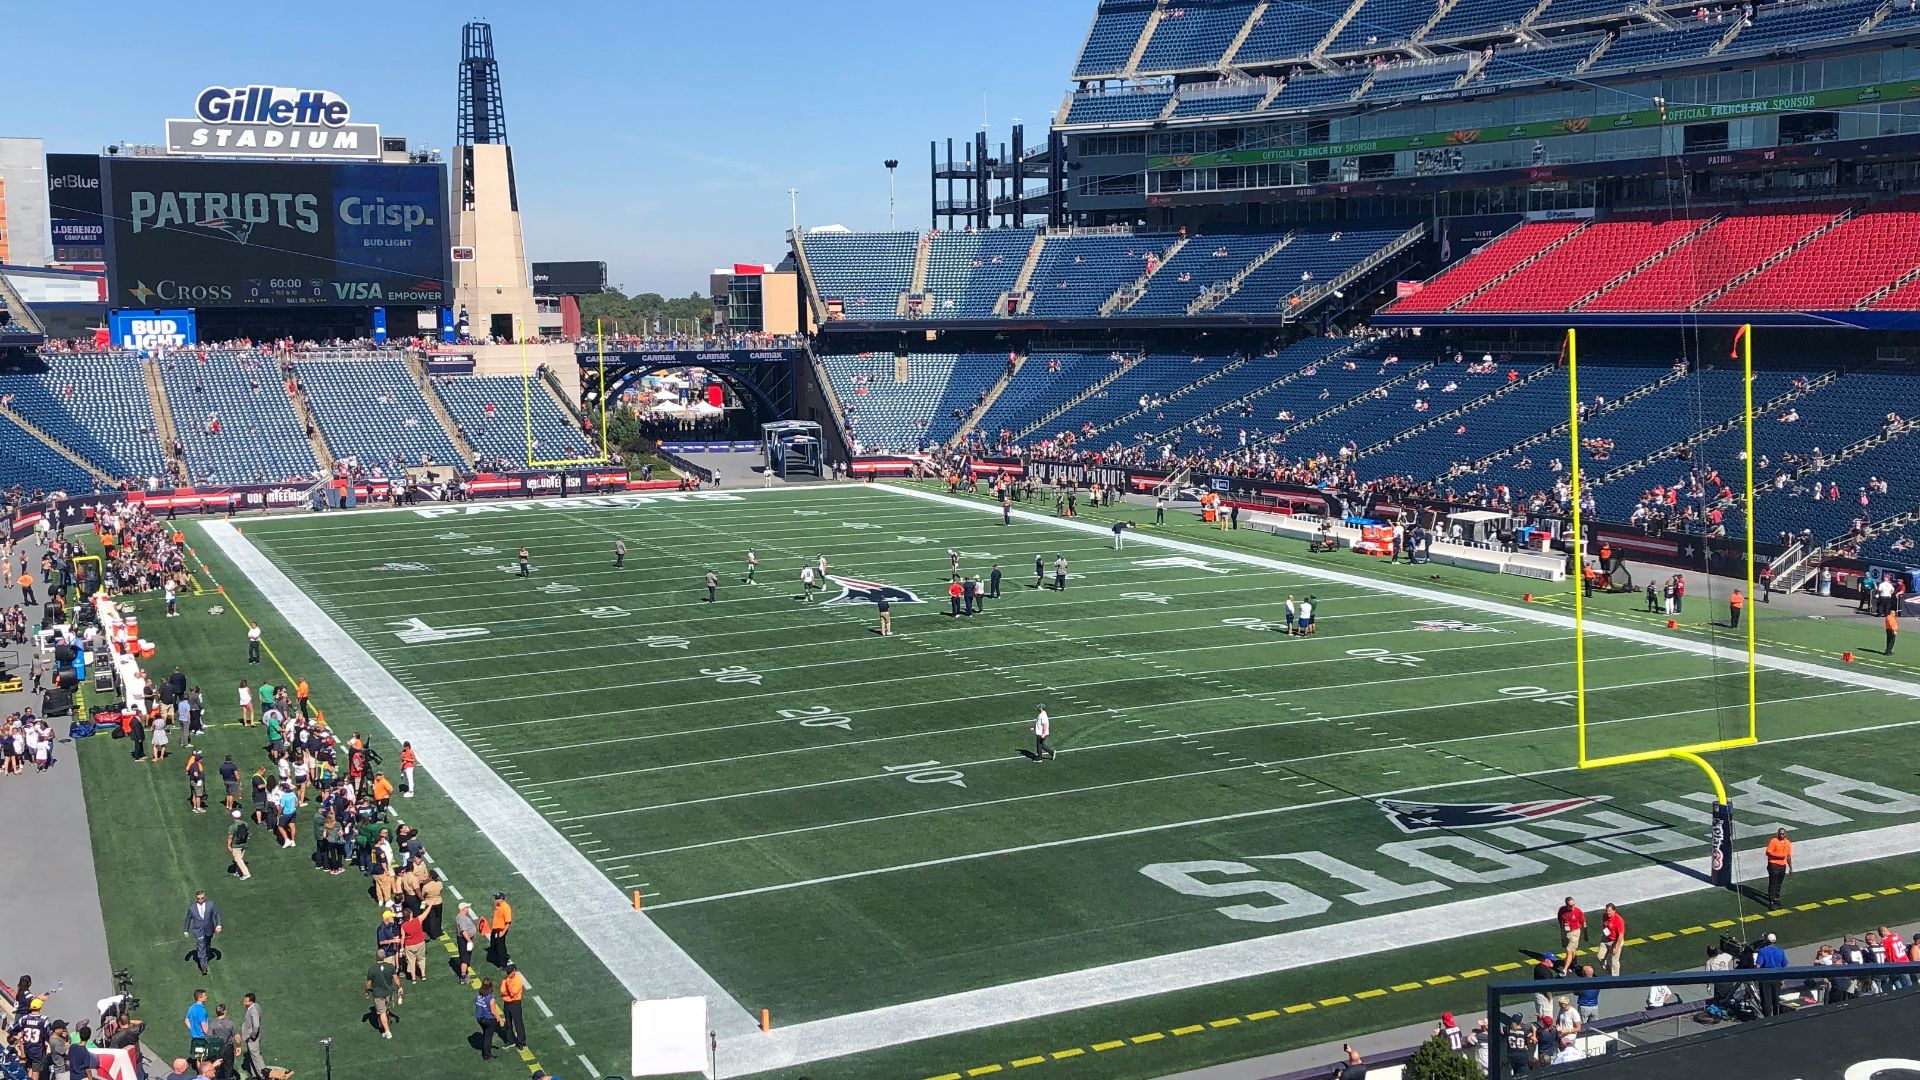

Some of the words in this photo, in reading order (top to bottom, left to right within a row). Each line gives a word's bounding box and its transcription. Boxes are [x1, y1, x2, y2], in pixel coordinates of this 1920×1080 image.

[197, 85, 349, 128] Gillette
[1668, 108, 1706, 121] OFFICIAL
[1711, 104, 1749, 116] FRENCH
[1750, 101, 1768, 112] FRY
[1773, 95, 1815, 110] SPONSOR
[190, 128, 358, 150] STADIUM
[1262, 148, 1295, 160] OFFICIAL
[1298, 146, 1328, 158] FRENCH
[1329, 144, 1343, 155] FRY
[1345, 141, 1377, 153] SPONSOR
[50, 174, 99, 190] jetBlue
[131, 191, 320, 234] PATRIOTS
[339, 196, 434, 231] Crisp.
[363, 238, 385, 247] BUD
[386, 238, 413, 247] LIGHT
[251, 287, 259, 297] 0
[270, 278, 302, 288] 60:00
[313, 287, 321, 296] 0
[330, 282, 383, 300] VISA
[388, 291, 442, 301] EMPOWER
[131, 319, 177, 335] BUD
[123, 334, 186, 350] LIGHT
[1029, 462, 1046, 479] NEW
[1049, 464, 1084, 482] ENGLAND
[1086, 468, 1126, 486] PATRIOTS
[699, 665, 762, 685] 30
[776, 705, 852, 729] 20
[883, 760, 966, 786] 10
[23, 1027, 41, 1044] 33
[1449, 1032, 1463, 1050] 11
